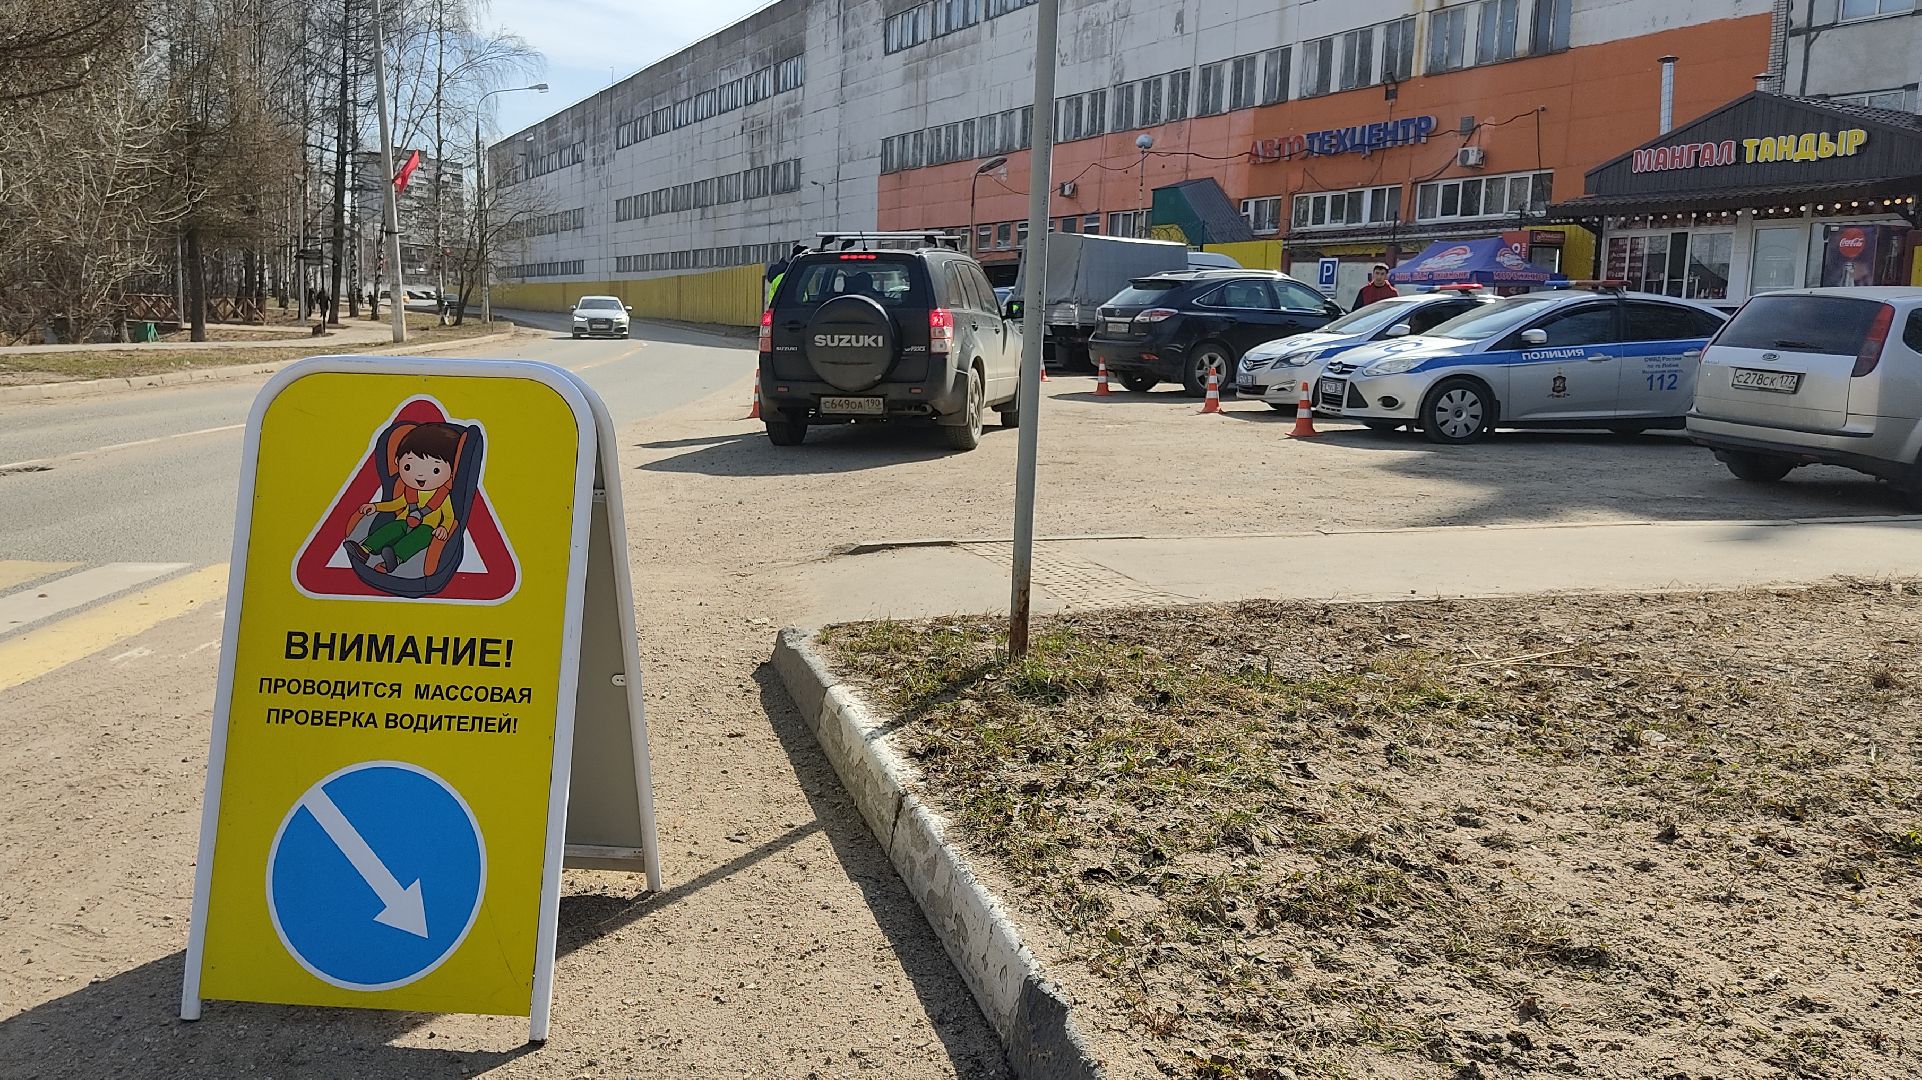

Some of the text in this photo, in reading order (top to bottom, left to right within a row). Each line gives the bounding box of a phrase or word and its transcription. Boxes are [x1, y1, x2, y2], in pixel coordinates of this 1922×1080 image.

[1632, 129, 1867, 173] МАНГАЛ ТАНДЫР
[1322, 263, 1333, 282] P
[814, 335, 884, 347] SUZUKI
[1521, 348, 1585, 360] ПОЛИЦИЯ
[1647, 373, 1678, 391] 112
[285, 631, 513, 668] ВНИМАНИЕ!
[259, 677, 532, 704] ПРОВОДИТСЯ МАССОВАЯ
[266, 708, 518, 734] ПРОВЕРКА ВОДИТЕЛЕЙ!
